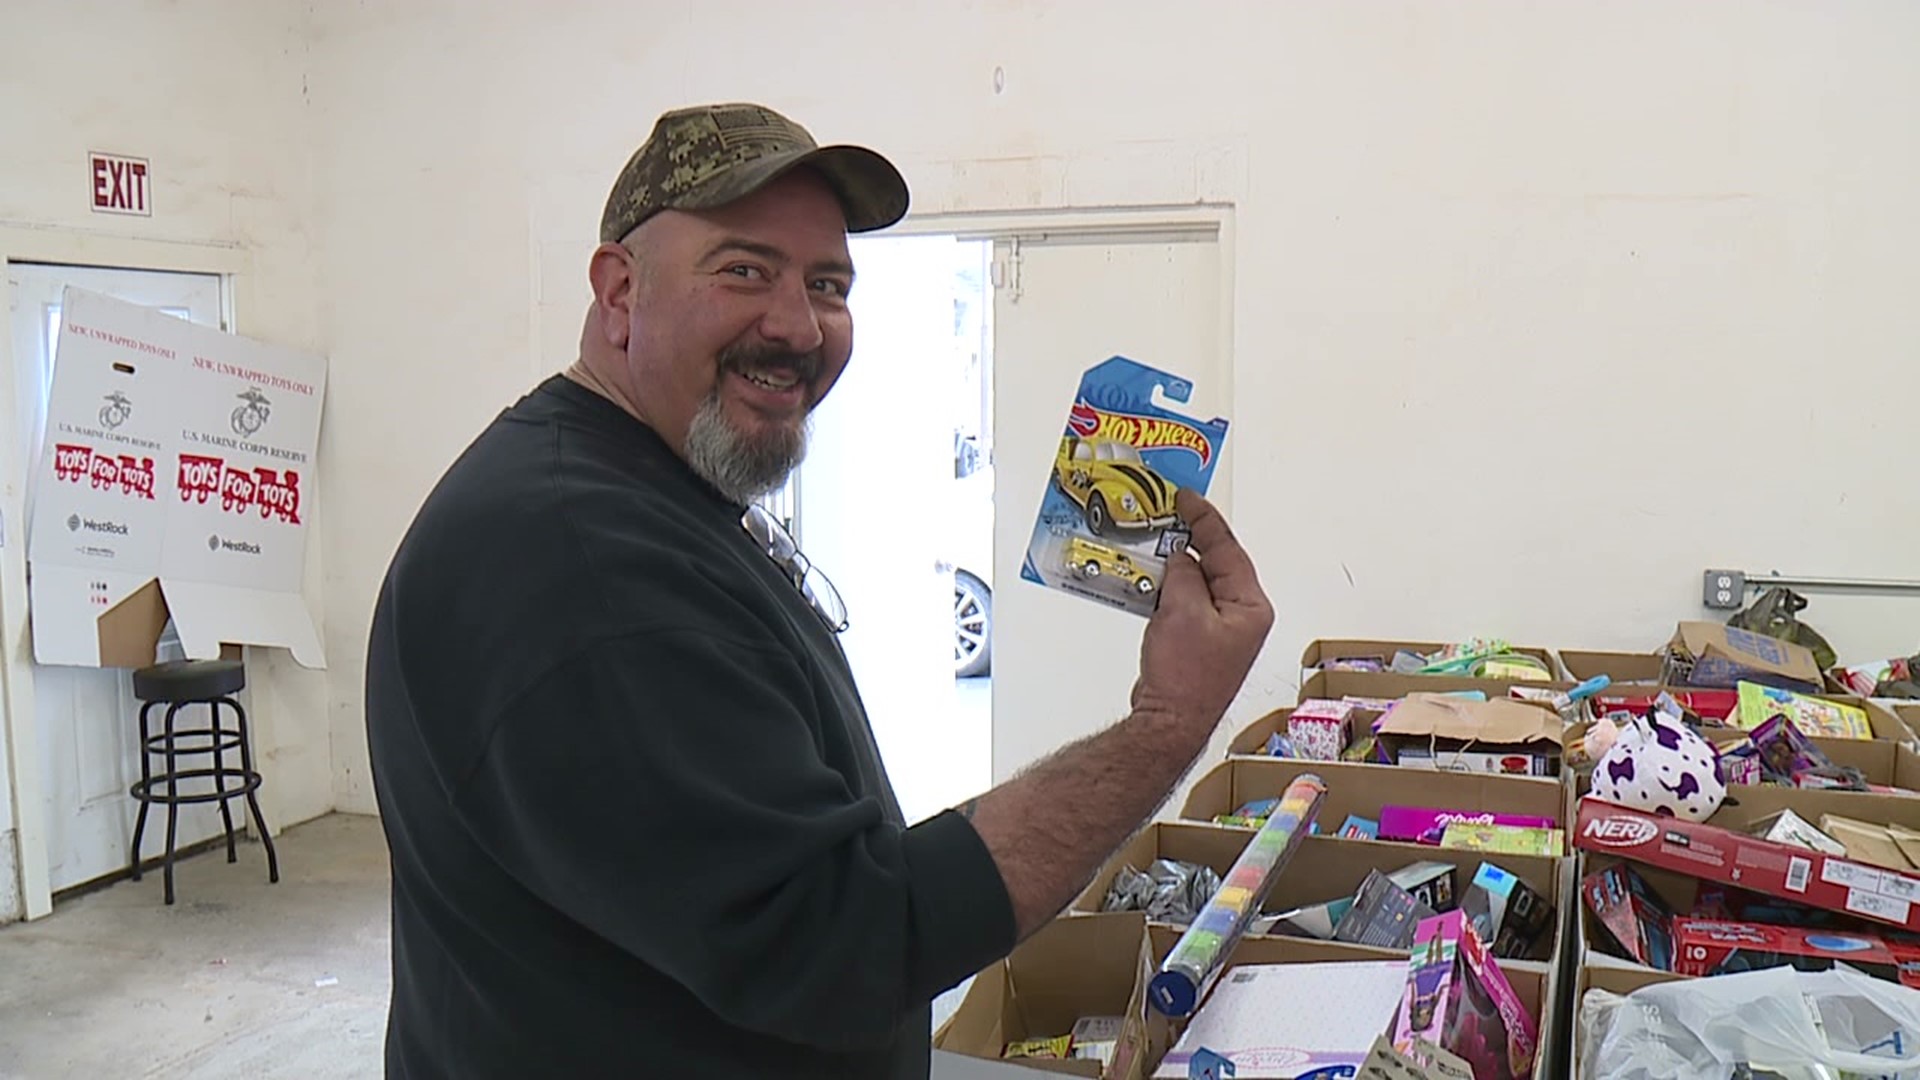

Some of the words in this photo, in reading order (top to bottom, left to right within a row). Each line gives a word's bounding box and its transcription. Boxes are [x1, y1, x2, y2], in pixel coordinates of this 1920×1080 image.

[92, 157, 146, 211] EXIT
[90, 328, 138, 349] UNWRAPPED
[138, 341, 157, 354] TOYS
[217, 362, 271, 385] UNWRAPPED
[271, 375, 292, 391] TOYS
[292, 381, 315, 396] ONLY
[75, 426, 104, 439] MARINE
[105, 433, 130, 444] CORPS
[131, 437, 161, 450] RESERVE
[1099, 413, 1141, 445] HOT
[201, 433, 238, 450] MARINE
[239, 440, 269, 456] CORPS
[270, 447, 307, 463] RESERVE
[58, 449, 88, 471] TOYS
[93, 458, 117, 481] FOR
[122, 467, 151, 491] TOTS
[181, 461, 219, 490] TOYS
[225, 472, 252, 499] FOR
[261, 483, 296, 513] TOTS
[83, 518, 128, 535] WestRock
[221, 538, 262, 554] WestRock
[1583, 817, 1651, 841] NERF
